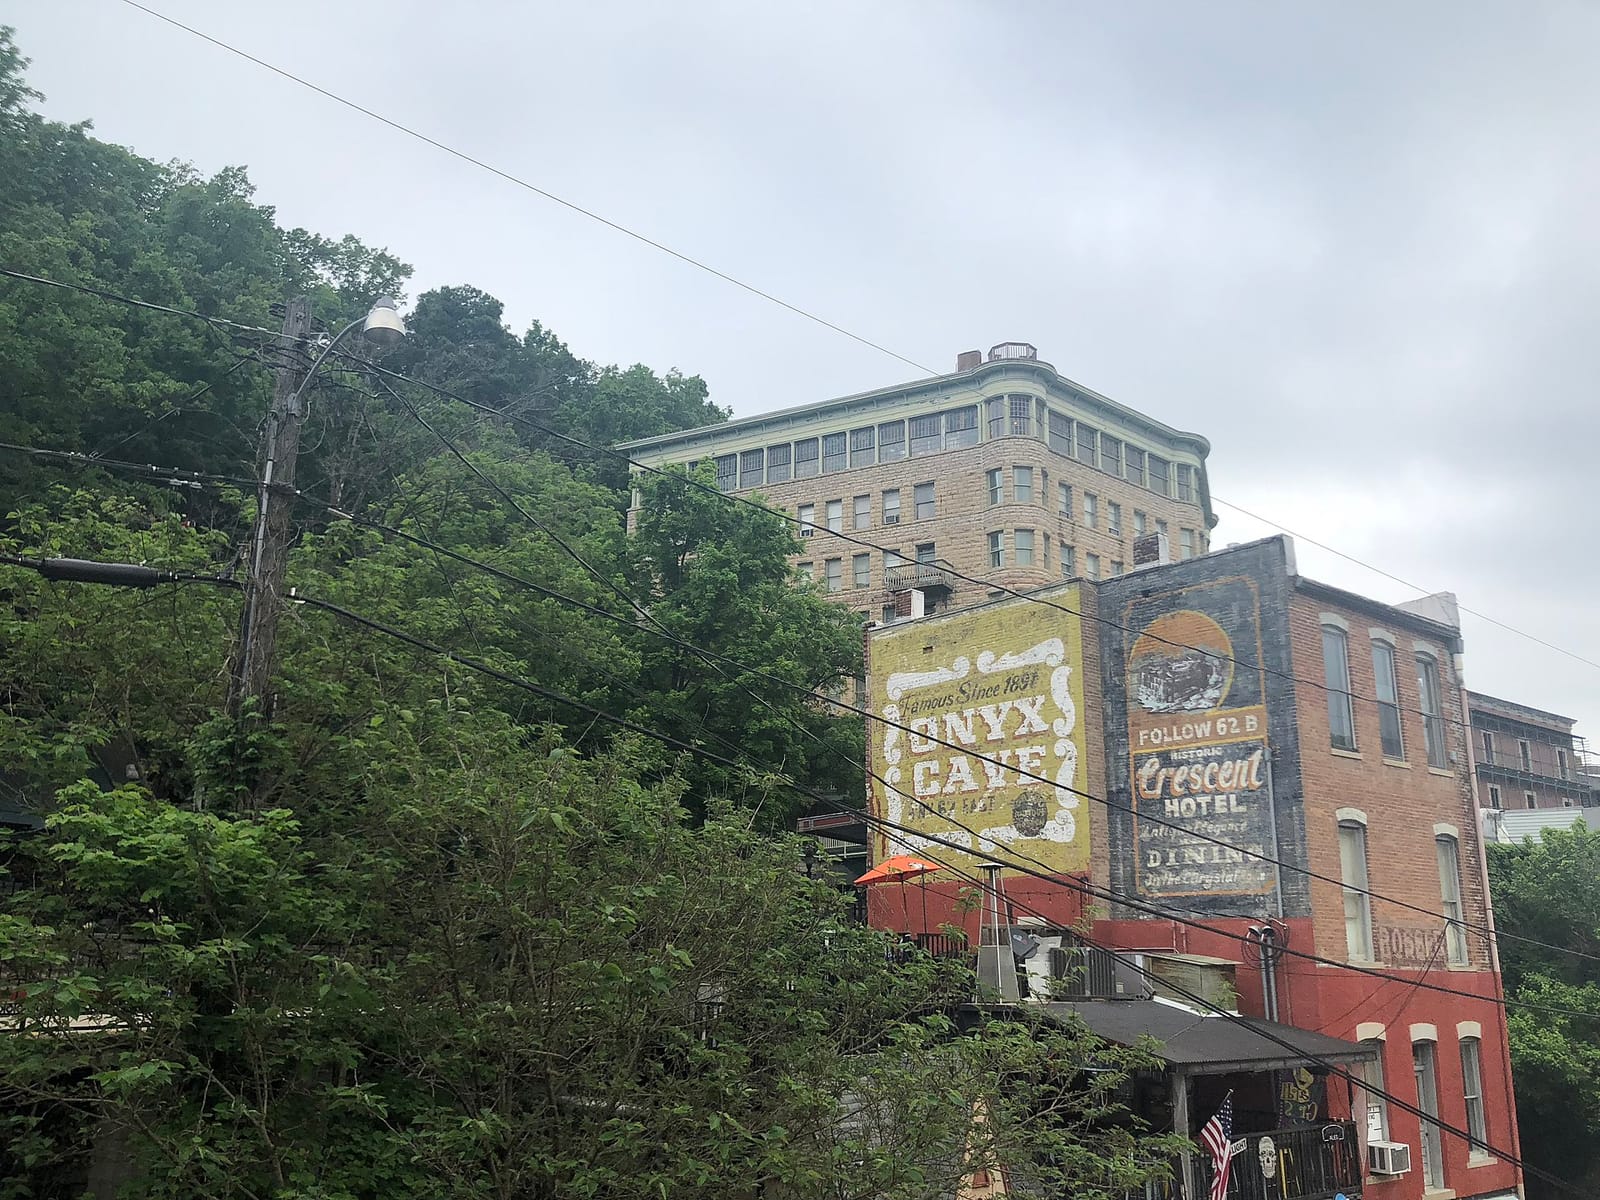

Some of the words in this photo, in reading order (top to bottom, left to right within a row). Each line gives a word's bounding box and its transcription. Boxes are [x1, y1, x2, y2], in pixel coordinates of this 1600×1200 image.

[899, 693, 954, 717] Famous
[956, 680, 1000, 705] Since
[910, 695, 1049, 754] ONYX
[1138, 721, 1212, 746] FOLLOW
[1216, 717, 1241, 736] 62
[1245, 715, 1258, 732] B
[1170, 747, 1224, 760] HISTORIC
[913, 746, 1047, 797] CAVE
[1136, 750, 1264, 799] Crescent
[1164, 794, 1248, 818] HOTEL
[1146, 843, 1265, 868] DINING
